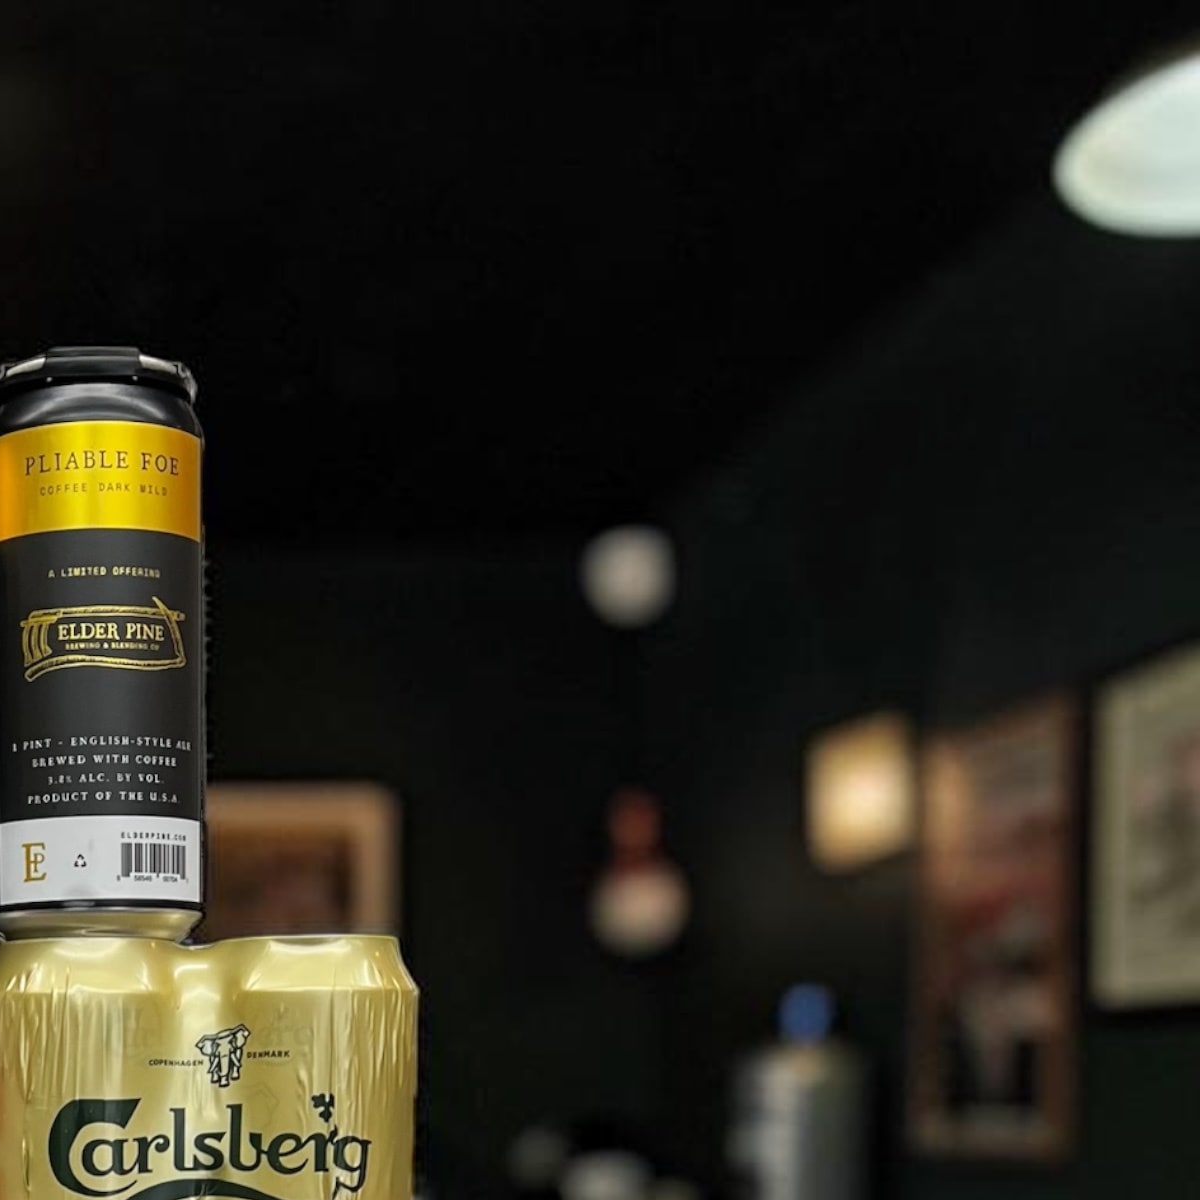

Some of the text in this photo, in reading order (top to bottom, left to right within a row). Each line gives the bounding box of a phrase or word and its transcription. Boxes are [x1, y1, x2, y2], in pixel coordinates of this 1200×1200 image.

[24, 450, 179, 476] PLIABLE FOE
[39, 482, 168, 496] COFFEE DARK MILD
[48, 566, 160, 578] A LIMITED OFFERING
[57, 622, 164, 641] ELDER PINE
[64, 641, 100, 650] BREWING
[111, 641, 148, 650] BLENDING
[23, 738, 52, 749] PINT
[70, 736, 172, 748] ENGLISH-STYLE
[175, 740, 192, 750] ALE
[32, 754, 177, 767] BREWED WITH COFFEE
[78, 773, 110, 783] ALC.
[117, 773, 131, 782] BY
[28, 791, 88, 804] PRODUCT
[95, 791, 112, 801] OF
[119, 791, 144, 801] THE
[246, 1050, 290, 1059] DENMARK
[148, 1059, 204, 1067] COPENHAGEN
[48, 1097, 372, 1197] Carlsberg
